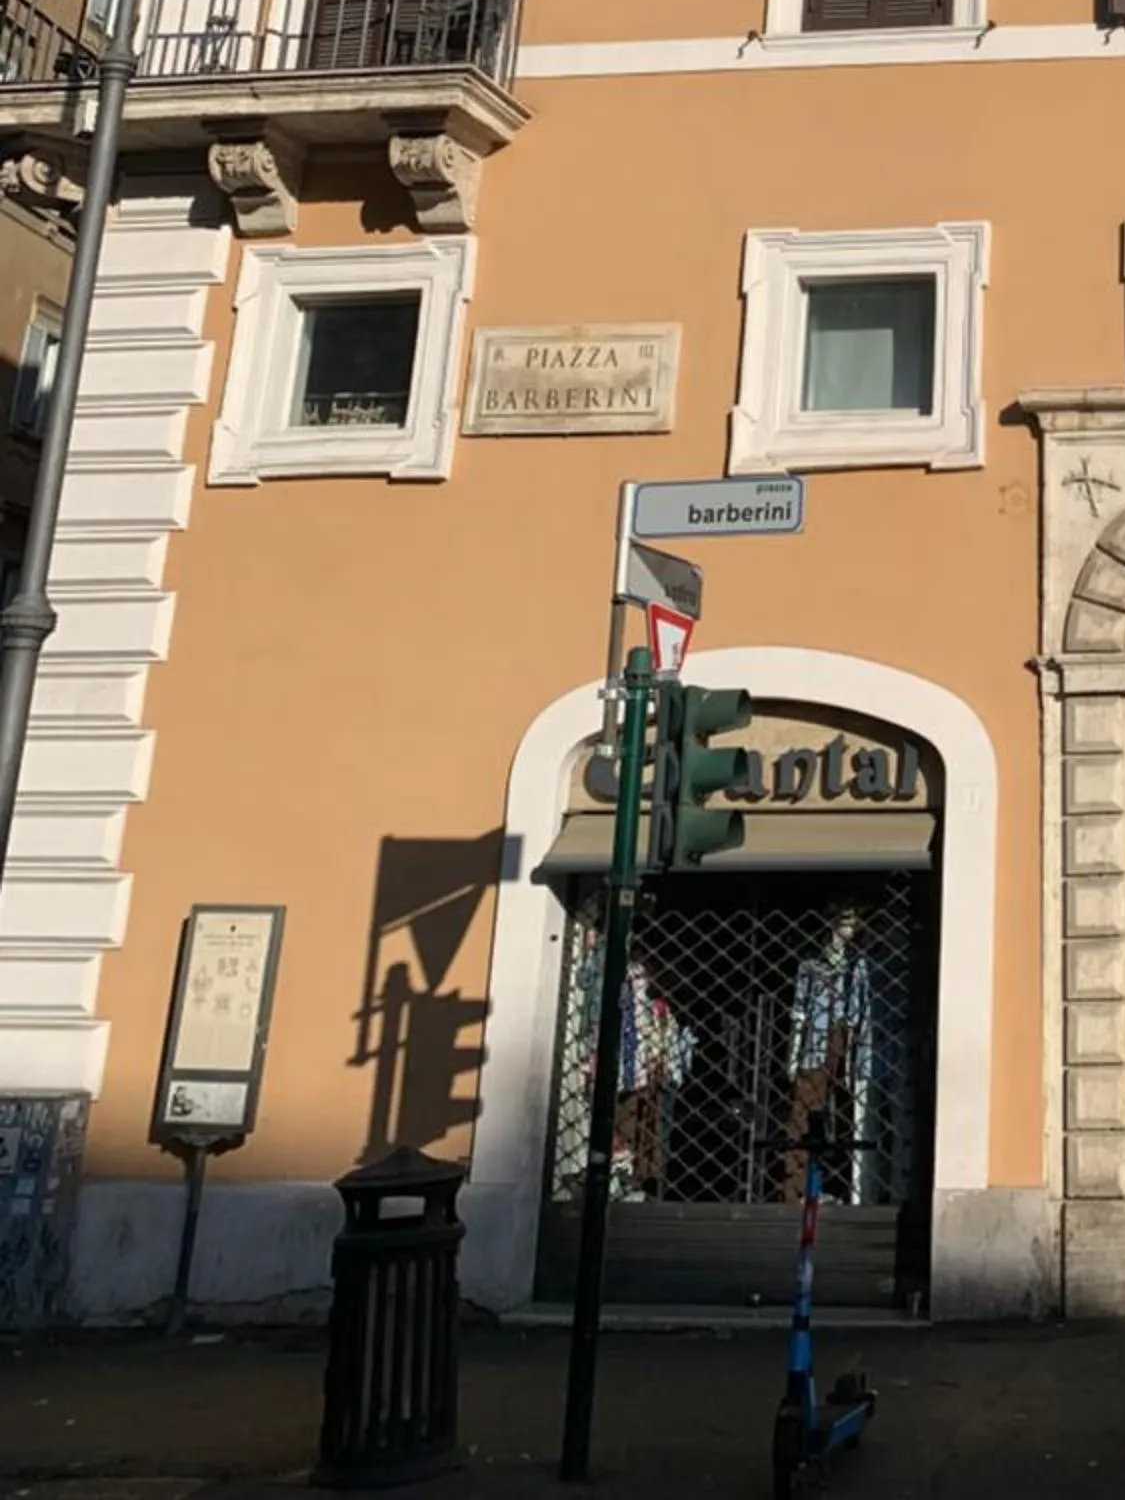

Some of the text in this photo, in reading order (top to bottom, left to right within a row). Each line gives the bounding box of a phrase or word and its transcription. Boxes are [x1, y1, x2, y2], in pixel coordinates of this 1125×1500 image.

[525, 346, 619, 369] PIAZZA
[485, 386, 653, 411] BARBERINI
[688, 501, 793, 525] barberini
[584, 732, 924, 805] Cantal
